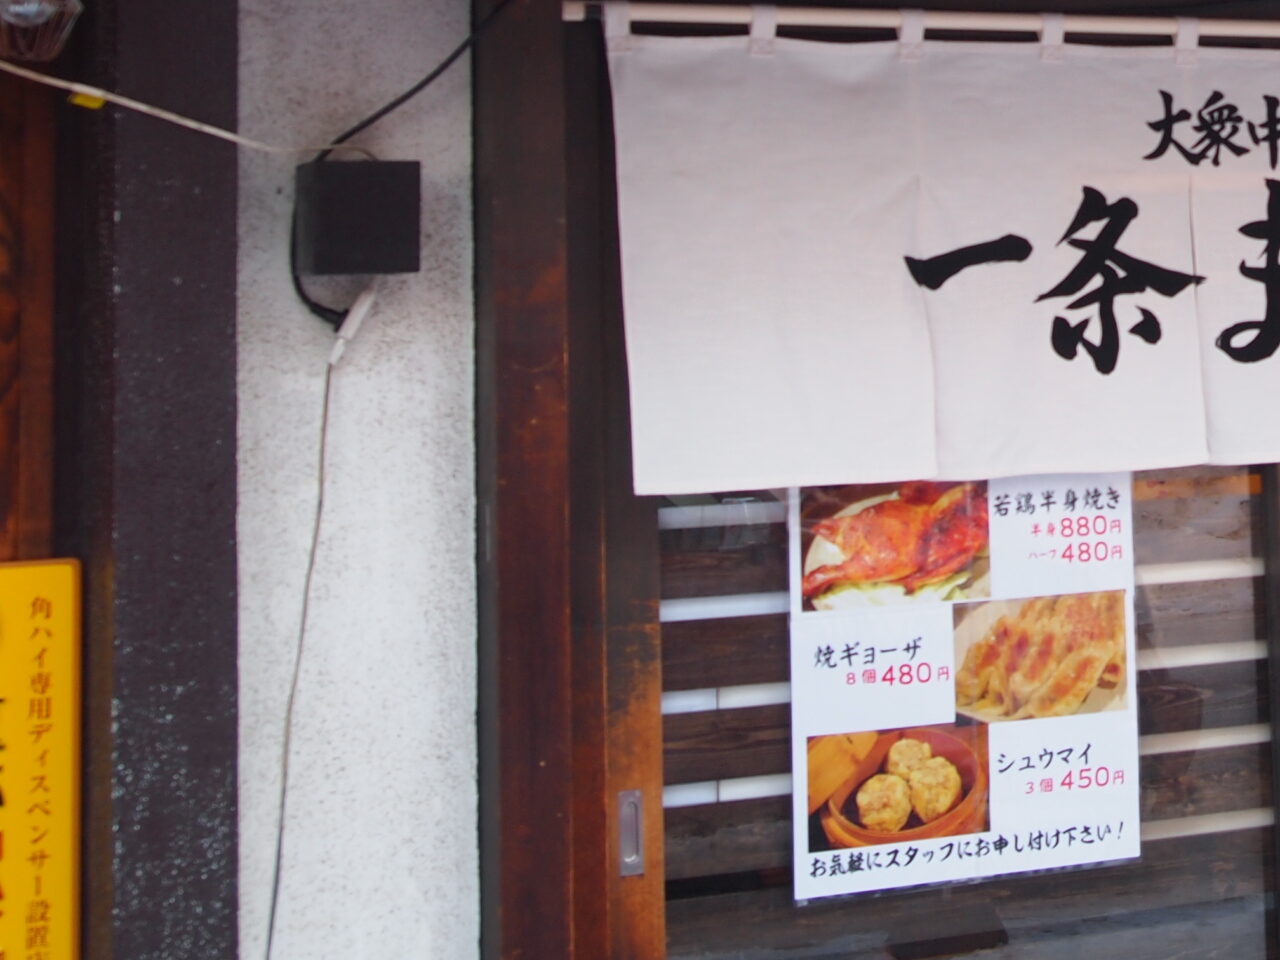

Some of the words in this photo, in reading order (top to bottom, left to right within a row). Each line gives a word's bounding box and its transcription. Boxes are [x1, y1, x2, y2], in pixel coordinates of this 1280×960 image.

[993, 487, 1120, 517] 若鶏半身焼き
[814, 637, 922, 669] 焼ギョーザ
[997, 743, 1092, 773] シュウマイ
[26, 595, 53, 960] 角ハイ専用ディスペンサー設置
